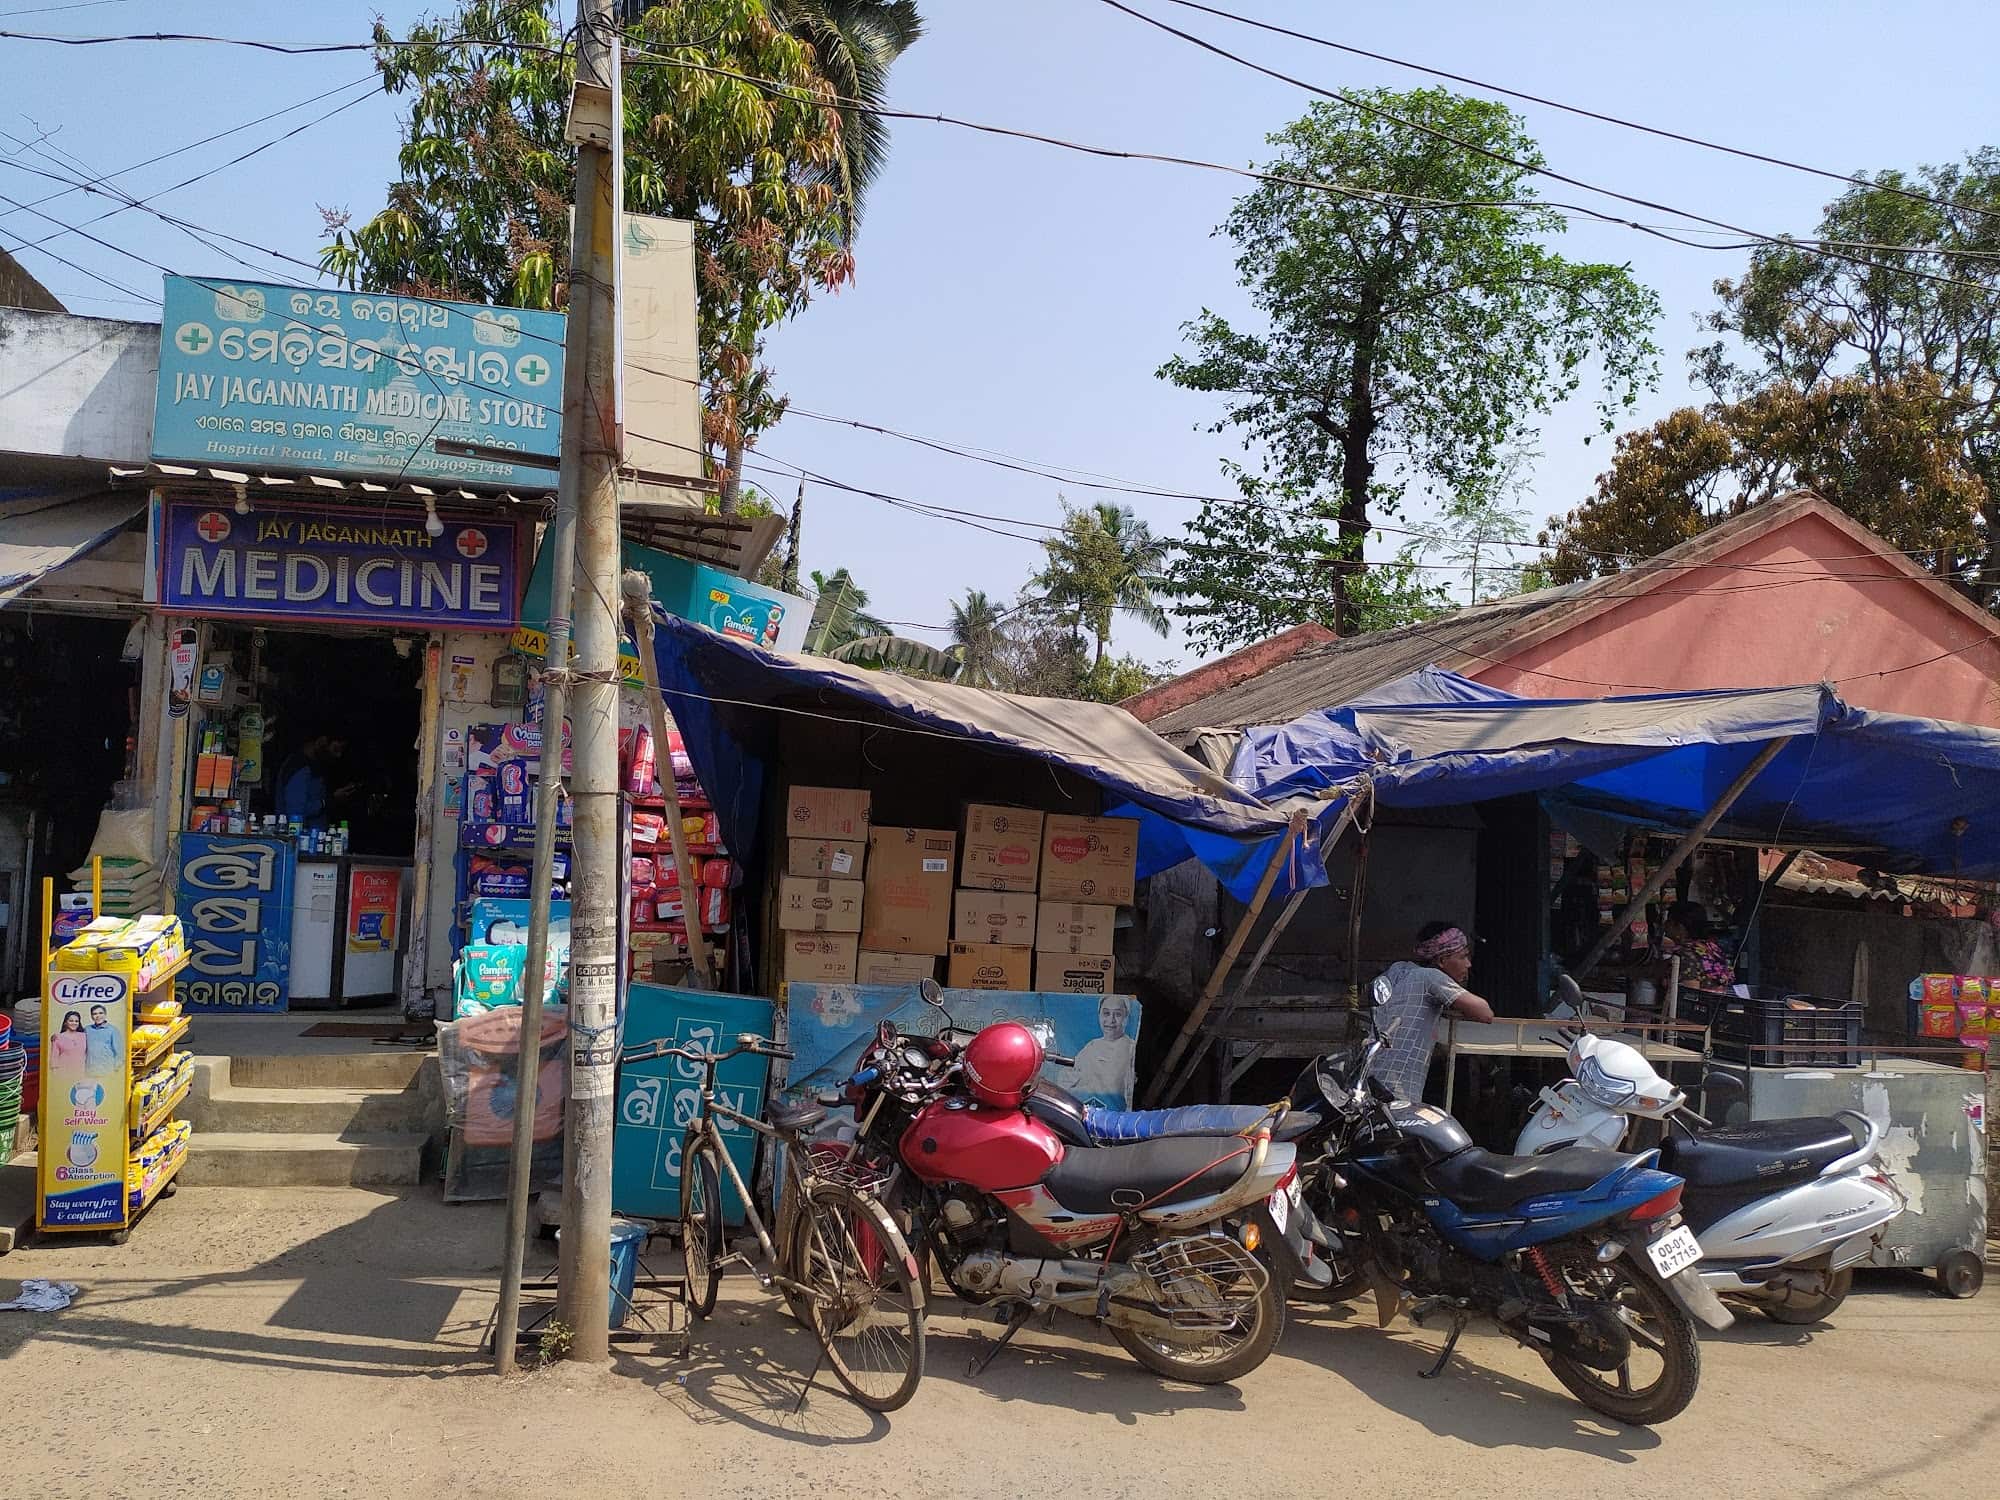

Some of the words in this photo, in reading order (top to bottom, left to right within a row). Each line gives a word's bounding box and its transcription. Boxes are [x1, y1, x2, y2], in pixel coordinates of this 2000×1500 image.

[290, 293, 341, 320] ଜୟ
[351, 299, 449, 333] ଜଗନ୍ନାଥ
[174, 372, 216, 405] JAY
[220, 376, 358, 413] JAGANNATH
[366, 387, 472, 423] MEDICINE
[479, 399, 547, 429] STORE
[195, 415, 245, 433] ଏଠାରେ
[207, 440, 275, 458] Hospital
[421, 458, 513, 476] 9040951448
[256, 520, 295, 543] JAY
[299, 522, 432, 549] JAGANNATH
[179, 547, 501, 612] MEDICINE
[723, 615, 759, 636] Pampers
[61, 983, 114, 998] Lifree
[74, 1109, 97, 1120] Easy
[84, 1117, 109, 1126] Wear
[55, 1166, 68, 1181] 6
[68, 1166, 94, 1174] Glass
[68, 1172, 116, 1181] Absorption
[49, 1199, 71, 1210] Stay
[71, 1200, 100, 1210] worry
[100, 1198, 118, 1210] free
[66, 1209, 112, 1222] confident!
[1657, 1235, 1685, 1258] OD-01
[1659, 1245, 1698, 1273] M-7715
